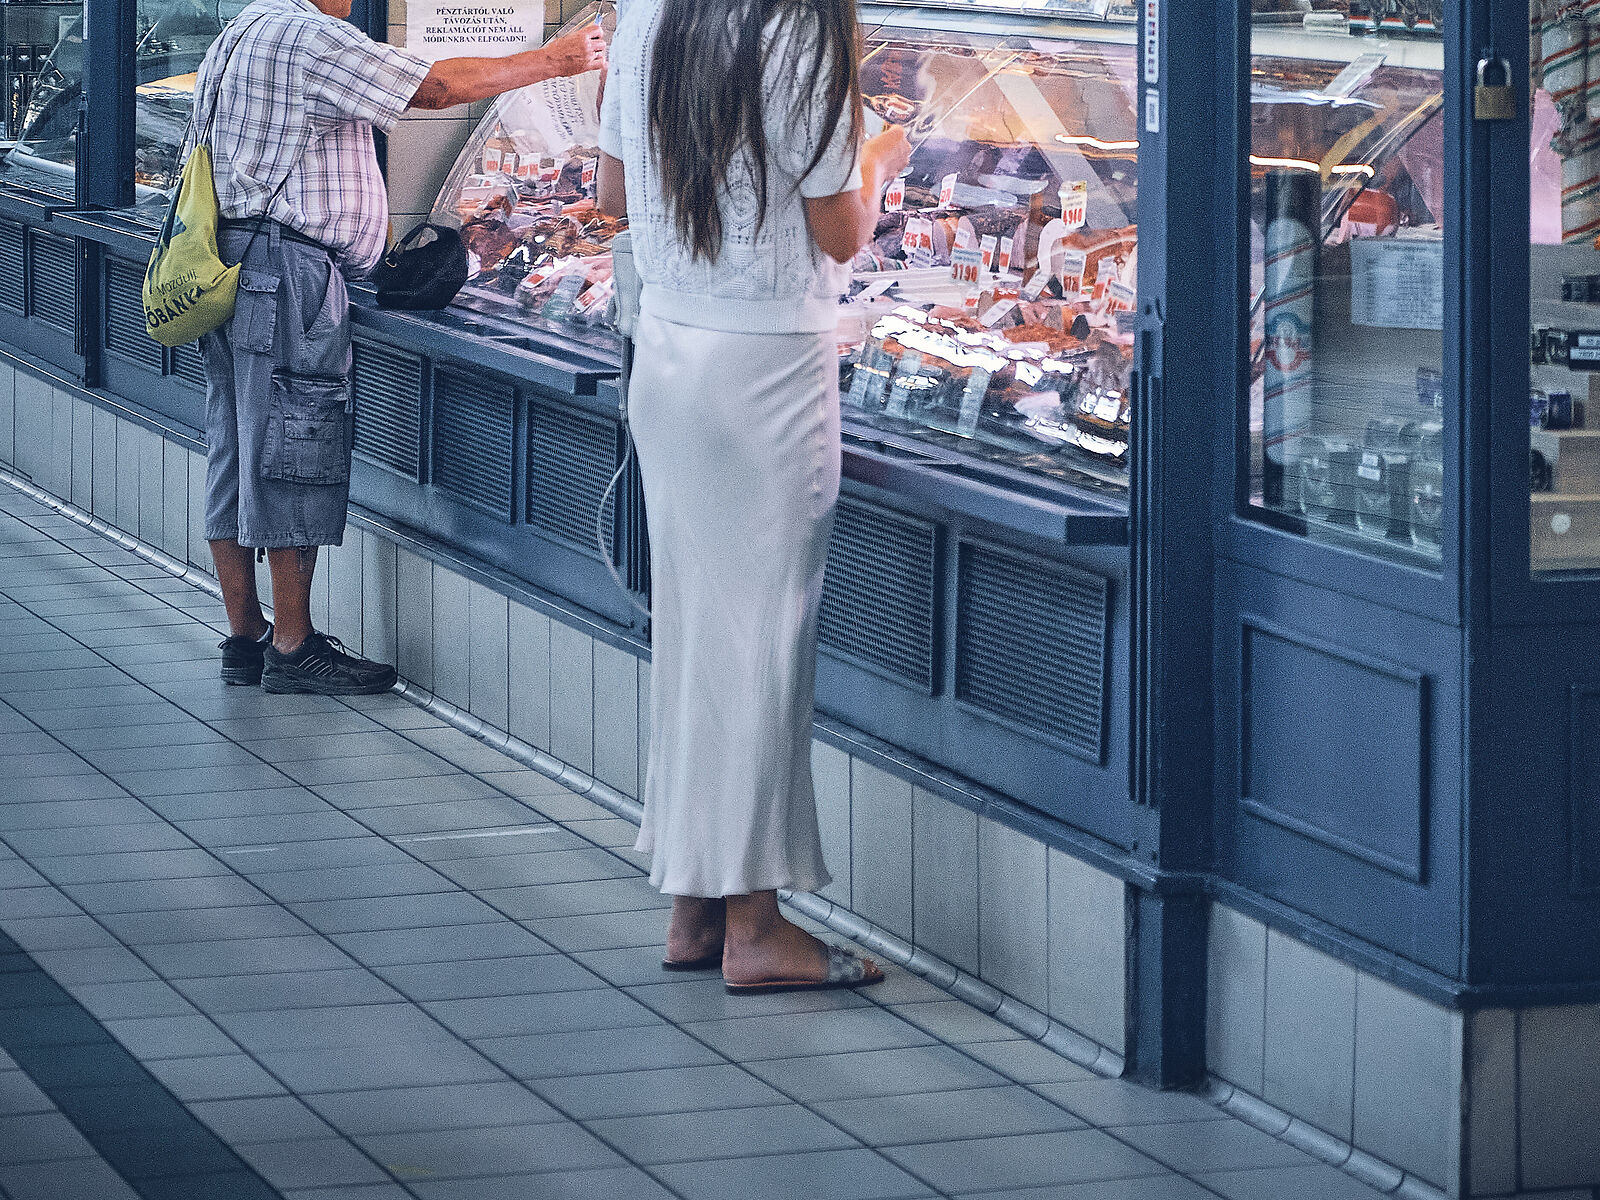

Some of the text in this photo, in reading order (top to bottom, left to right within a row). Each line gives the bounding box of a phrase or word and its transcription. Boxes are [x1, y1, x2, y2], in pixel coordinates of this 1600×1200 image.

[436, 6, 514, 16] PÉNZTÁRTÓL VALÓ
[443, 15, 508, 26] TÁVOZÁS UTÁN,
[426, 25, 524, 35] REKLAMÁCIÓT NEM ÁLL
[423, 34, 527, 44] MÓDUNKBAN ELFOGADNI!
